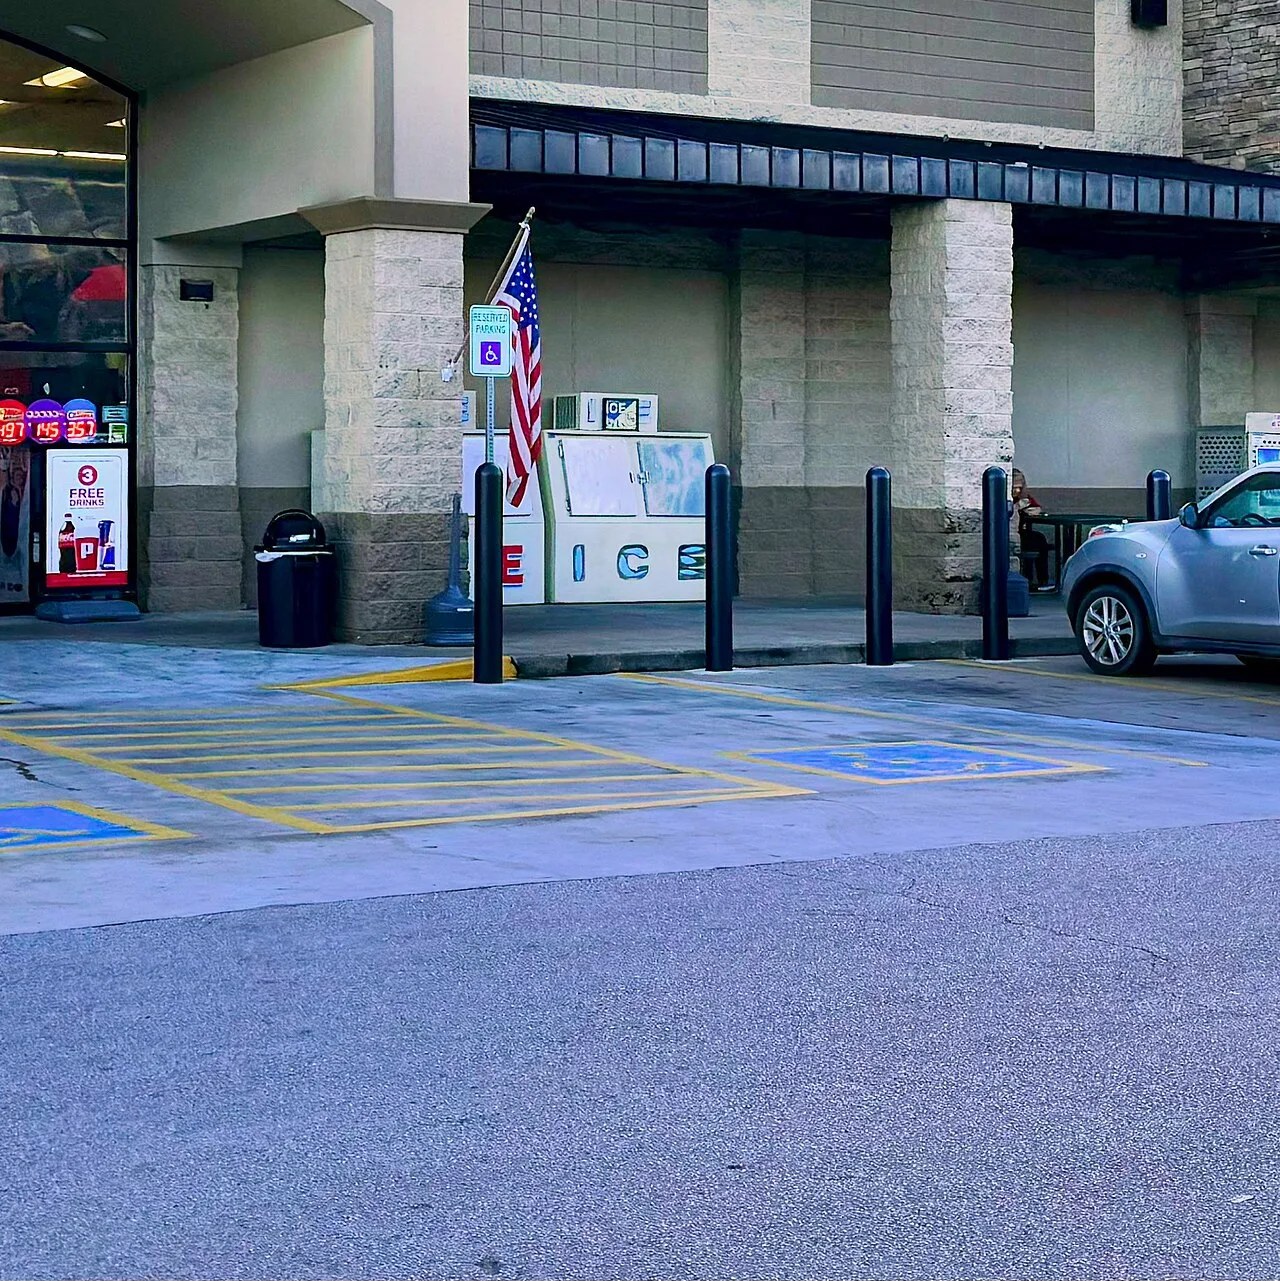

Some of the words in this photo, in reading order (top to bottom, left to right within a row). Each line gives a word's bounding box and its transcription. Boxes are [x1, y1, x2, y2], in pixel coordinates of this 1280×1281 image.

[475, 324, 506, 334] PARKING
[81, 468, 94, 483] 3
[69, 488, 105, 499] FREE
[69, 499, 105, 507] DRINKS
